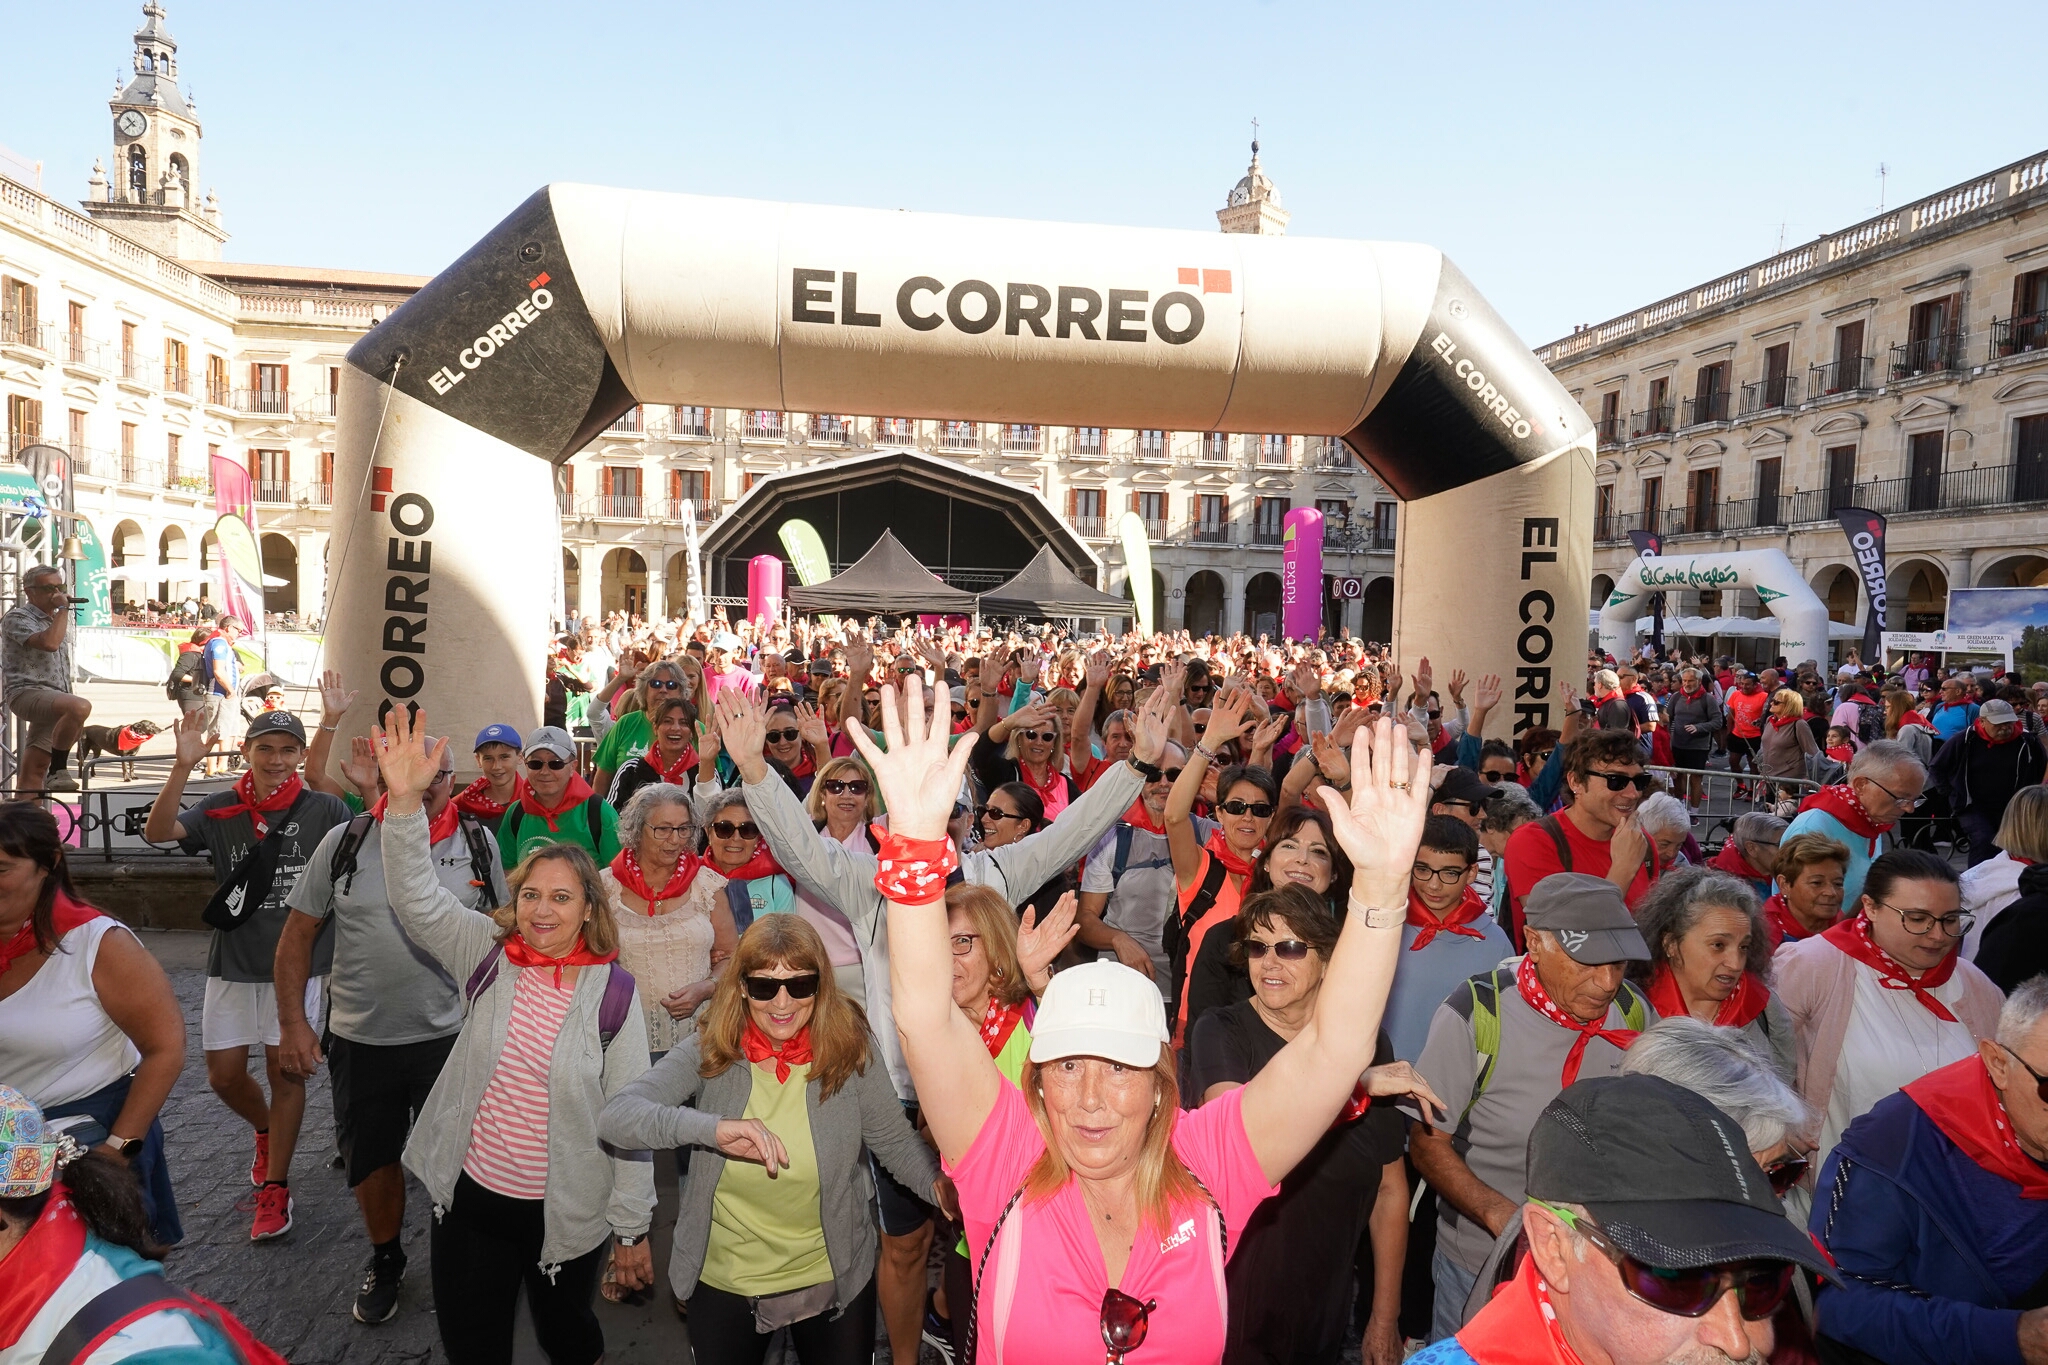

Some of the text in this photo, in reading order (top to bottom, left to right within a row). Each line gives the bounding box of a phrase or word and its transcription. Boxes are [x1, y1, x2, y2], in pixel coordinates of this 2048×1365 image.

[427, 288, 553, 396] EL CORREO
[792, 268, 1205, 345] EL CORREO
[1431, 332, 1531, 439] EL CORREO
[1286, 561, 1296, 604] kutxa
[1640, 560, 1738, 589] El Corte Inglés
[1513, 517, 1559, 750] EL CORR
[224, 883, 244, 909] NIKE
[1088, 988, 1107, 1006] H
[1710, 1119, 1750, 1200] SPORTS SPORTS
